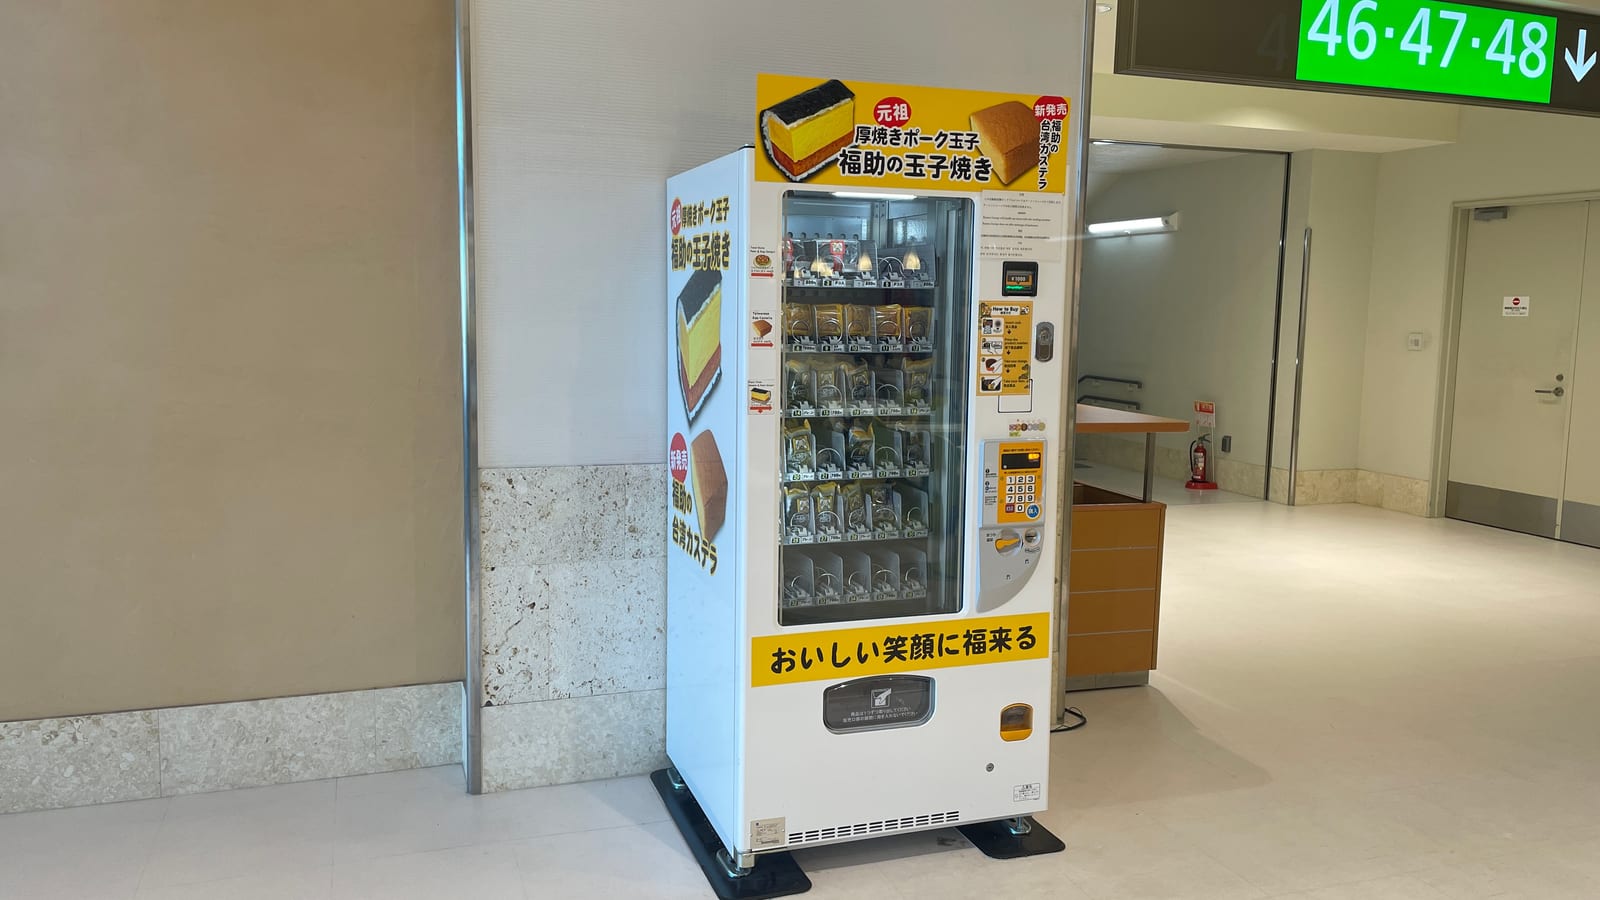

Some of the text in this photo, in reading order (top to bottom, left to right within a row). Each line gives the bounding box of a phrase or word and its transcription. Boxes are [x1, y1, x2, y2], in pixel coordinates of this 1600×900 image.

[876, 103, 909, 122] 元祖
[1034, 103, 1067, 117] 新発売
[854, 126, 980, 151] 厚焼きポーク玉子
[1051, 120, 1062, 153] 福助の
[838, 150, 993, 182] 福助の玉子焼き
[1037, 120, 1050, 190] 台湾カステラ
[671, 205, 681, 229] 元祖
[682, 197, 730, 229] 厚焼きポーク玉子
[671, 232, 731, 270] 福助の玉子焼き
[670, 449, 688, 471] 新発売
[672, 479, 693, 514] 福助の
[672, 515, 718, 576] 台湾カステラ
[770, 625, 1037, 674] おいしい笑顔に福来る
